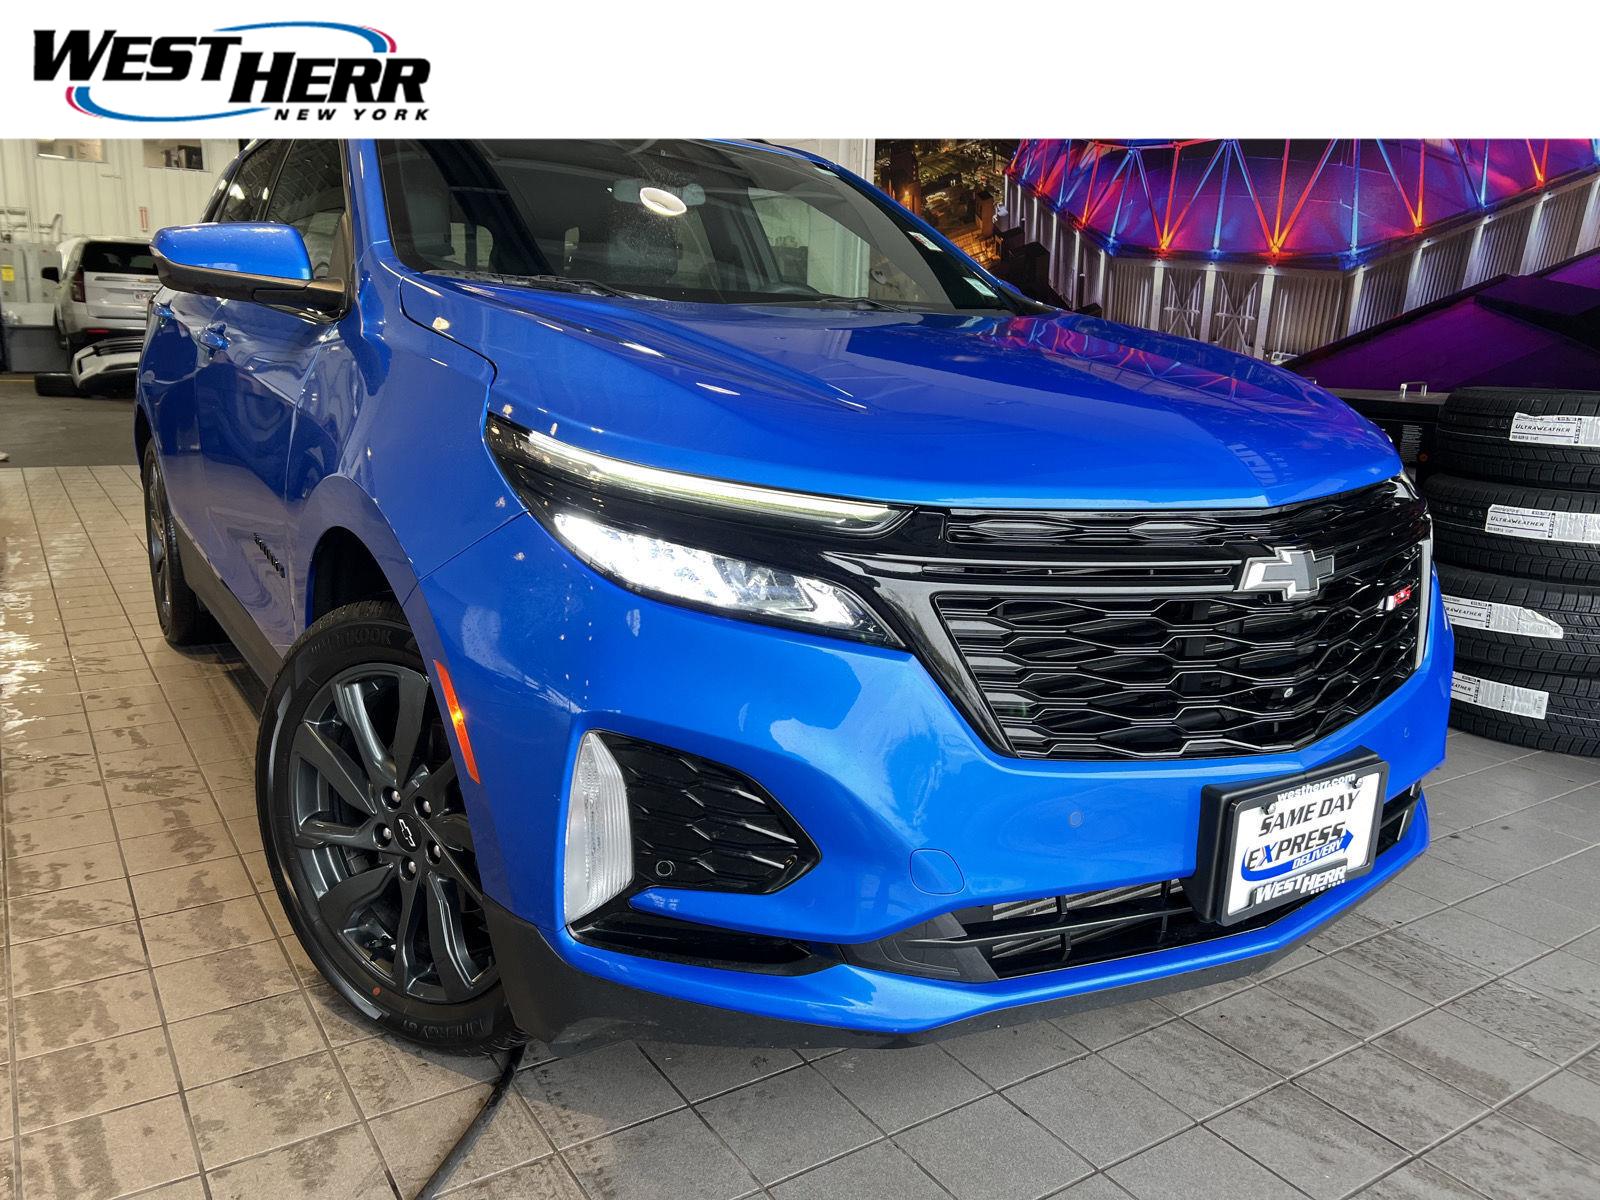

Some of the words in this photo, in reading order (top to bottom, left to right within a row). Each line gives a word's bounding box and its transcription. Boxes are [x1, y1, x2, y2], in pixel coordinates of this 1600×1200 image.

[1515, 423, 1571, 433] ULTRAWEATHER
[1490, 515, 1545, 528] ULTRAWEATHER
[1277, 773, 1357, 803] westherr.com
[1258, 801, 1317, 837] SAME
[1317, 789, 1361, 818] DAY
[1247, 821, 1346, 871] EXPRESS
[1291, 838, 1344, 870] DELIVERY
